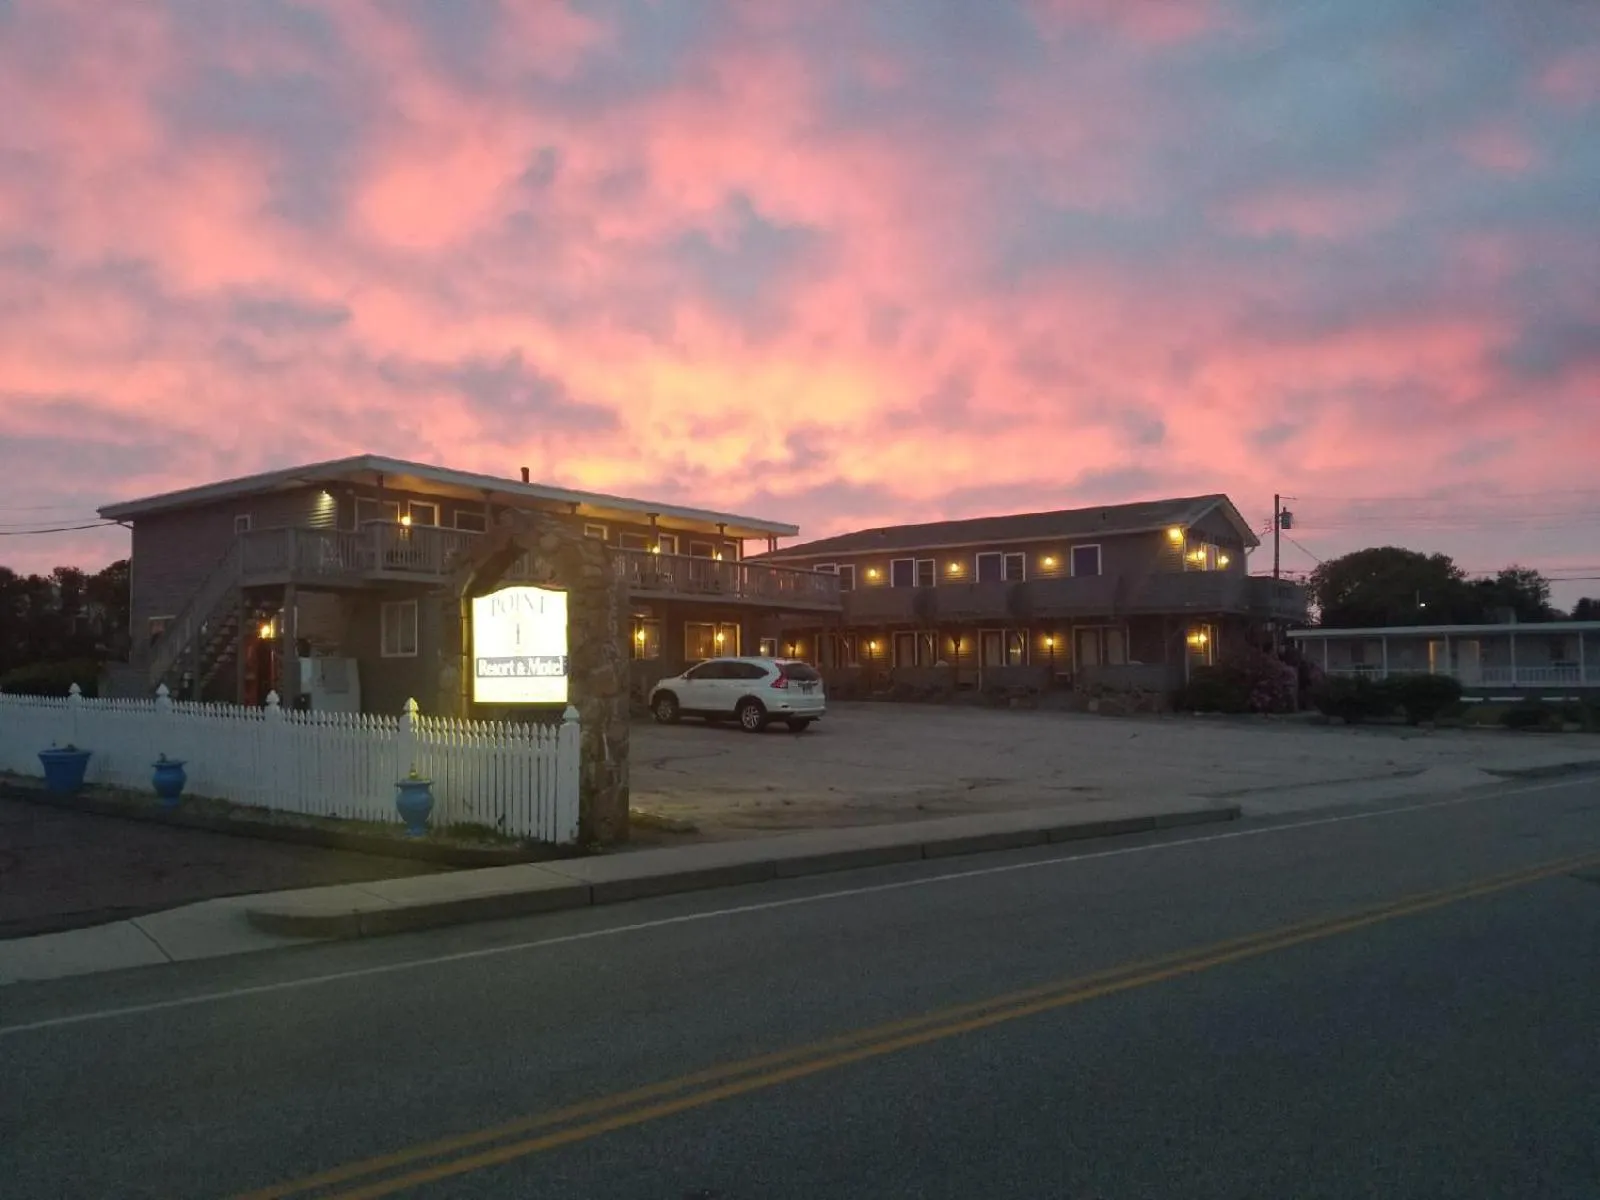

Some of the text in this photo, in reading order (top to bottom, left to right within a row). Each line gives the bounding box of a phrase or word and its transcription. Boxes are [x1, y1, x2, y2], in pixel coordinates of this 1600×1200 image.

[490, 592, 547, 617] POINT
[478, 655, 564, 676] Resort & Motel
